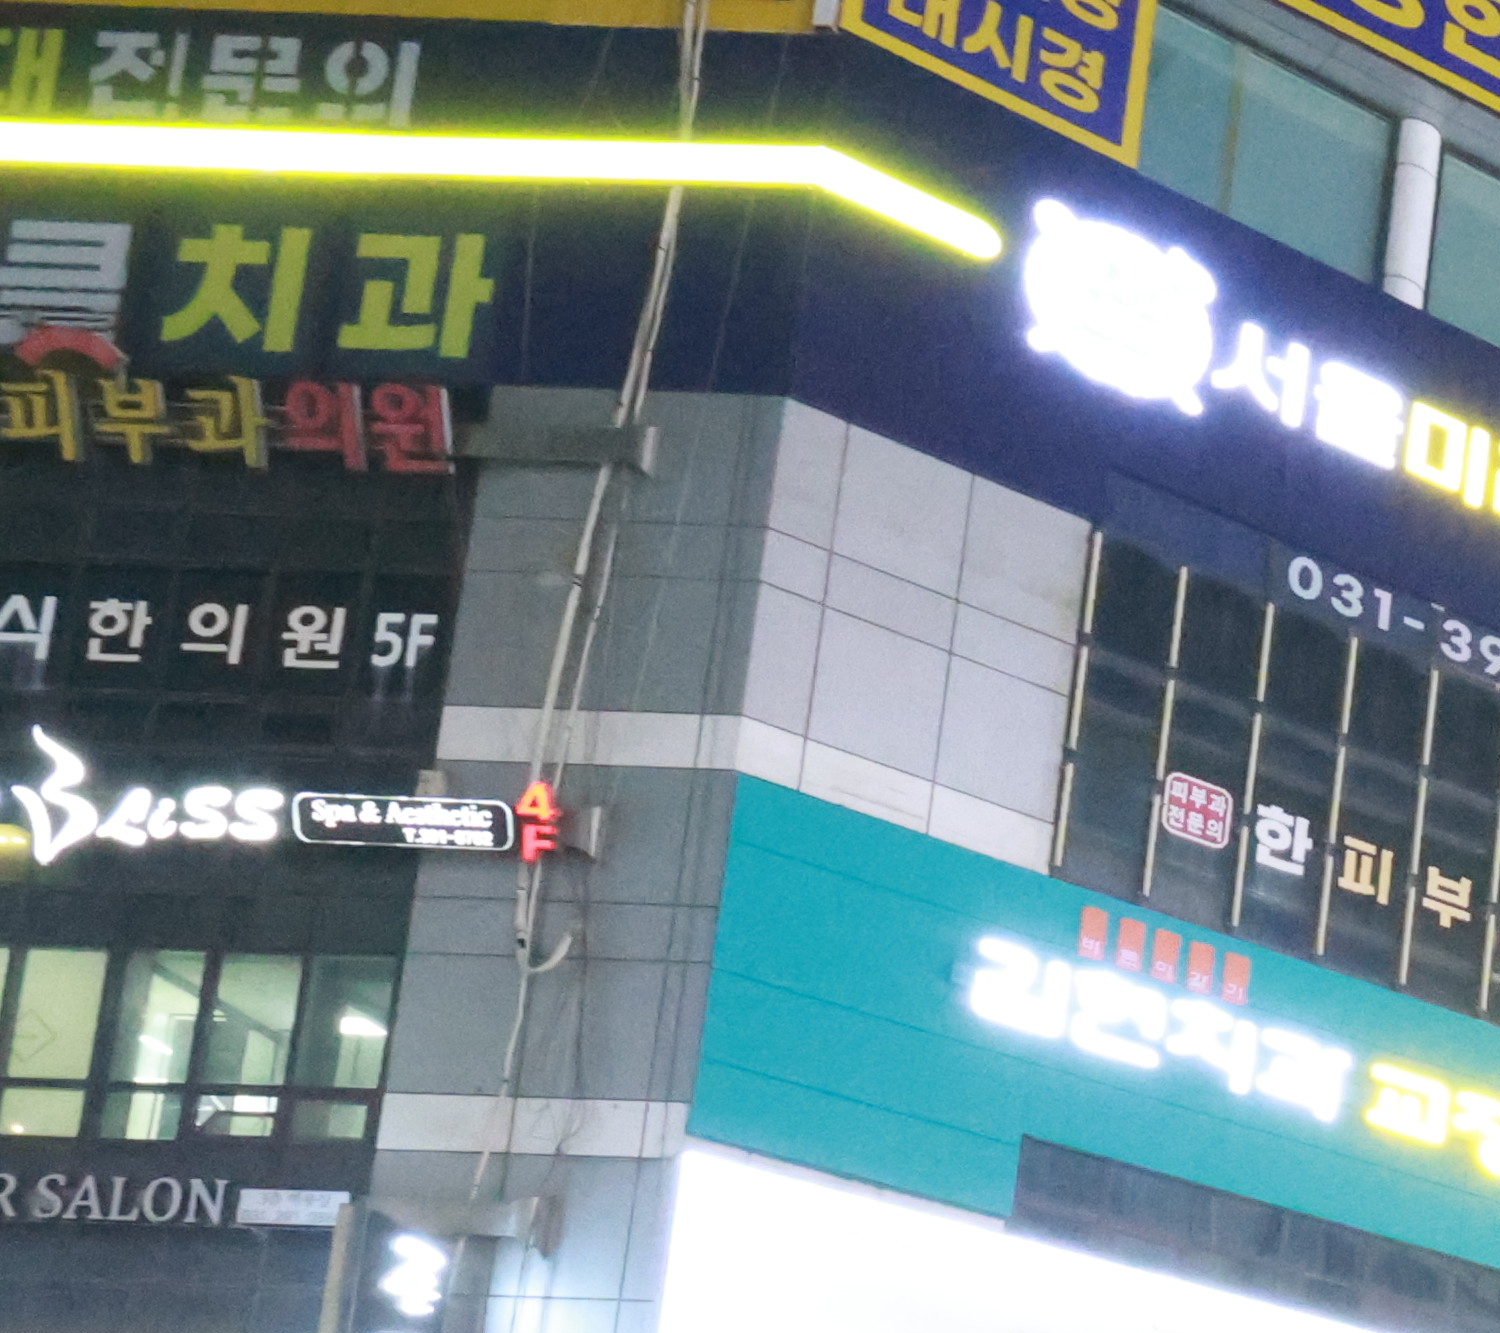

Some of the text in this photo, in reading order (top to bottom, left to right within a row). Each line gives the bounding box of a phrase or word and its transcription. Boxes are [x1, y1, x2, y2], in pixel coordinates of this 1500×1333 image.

[370, 611, 438, 669] 5F
[310, 801, 493, 830] Spa & Aesthetic
[1170, 780, 1228, 818] 피부과
[1167, 804, 1224, 843] 전문의
[36, 1173, 229, 1227] SALON
